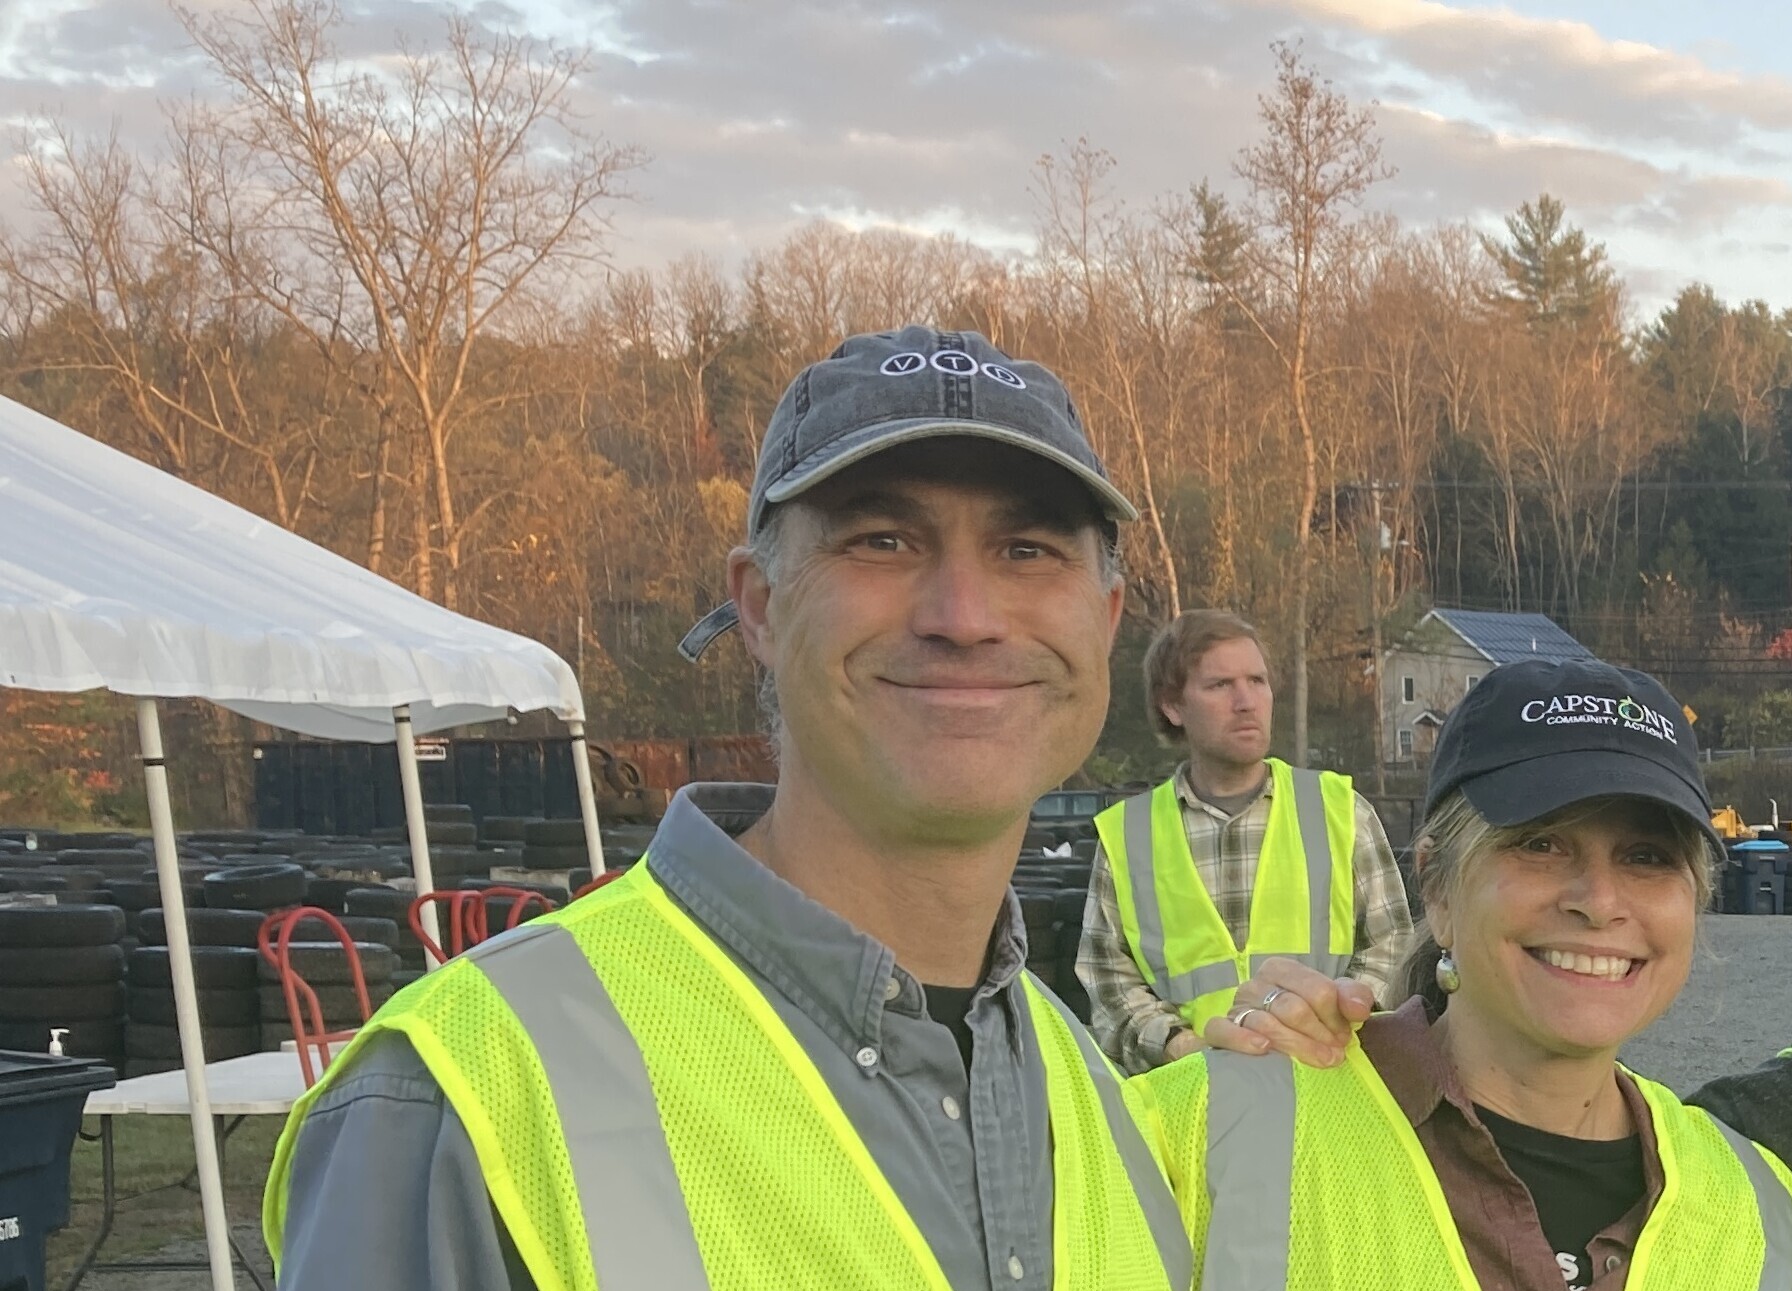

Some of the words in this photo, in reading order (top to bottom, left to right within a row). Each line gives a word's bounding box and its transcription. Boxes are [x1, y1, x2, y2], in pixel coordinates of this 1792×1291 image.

[1521, 695, 1678, 745] CAPSTONE
[1546, 714, 1618, 726] COMMUNITY
[1624, 720, 1664, 740] ACTION
